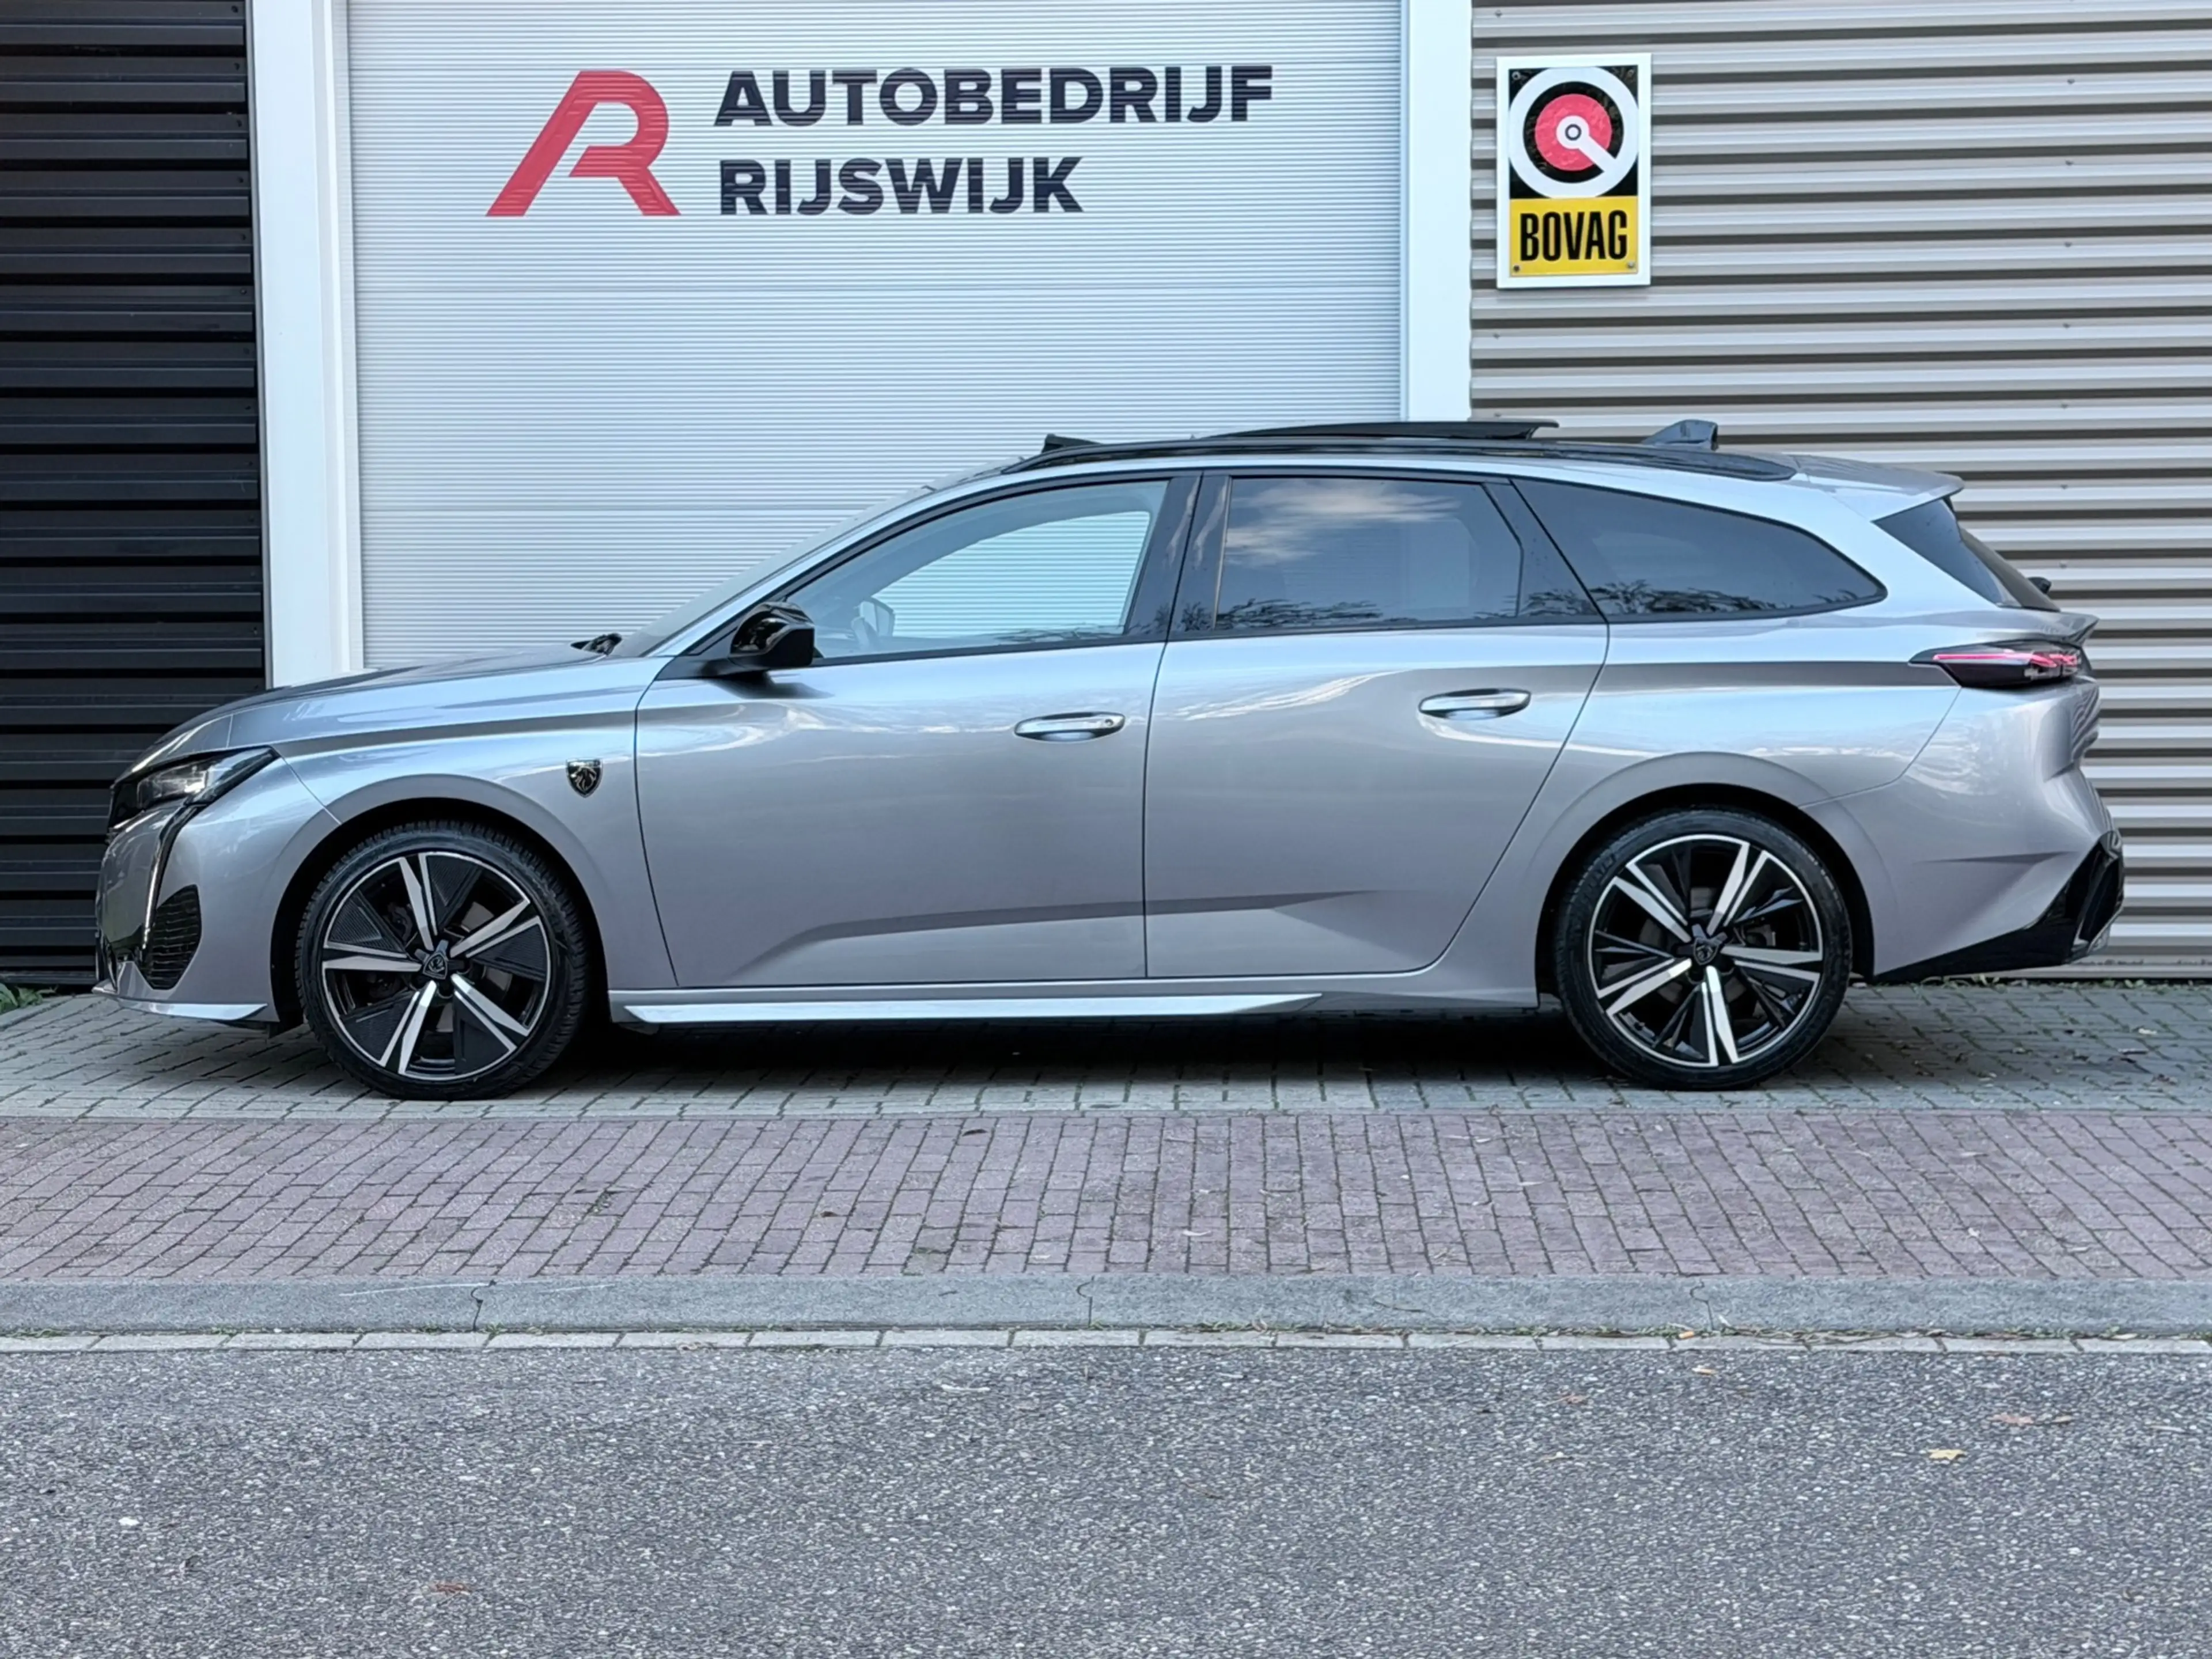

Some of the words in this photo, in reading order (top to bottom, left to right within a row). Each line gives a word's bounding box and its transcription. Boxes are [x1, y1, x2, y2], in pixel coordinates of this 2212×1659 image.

[714, 65, 1272, 127] AUTOBEDRIJF
[719, 157, 1083, 215] RIJSWIJK
[1520, 210, 1627, 262] BOVAG
